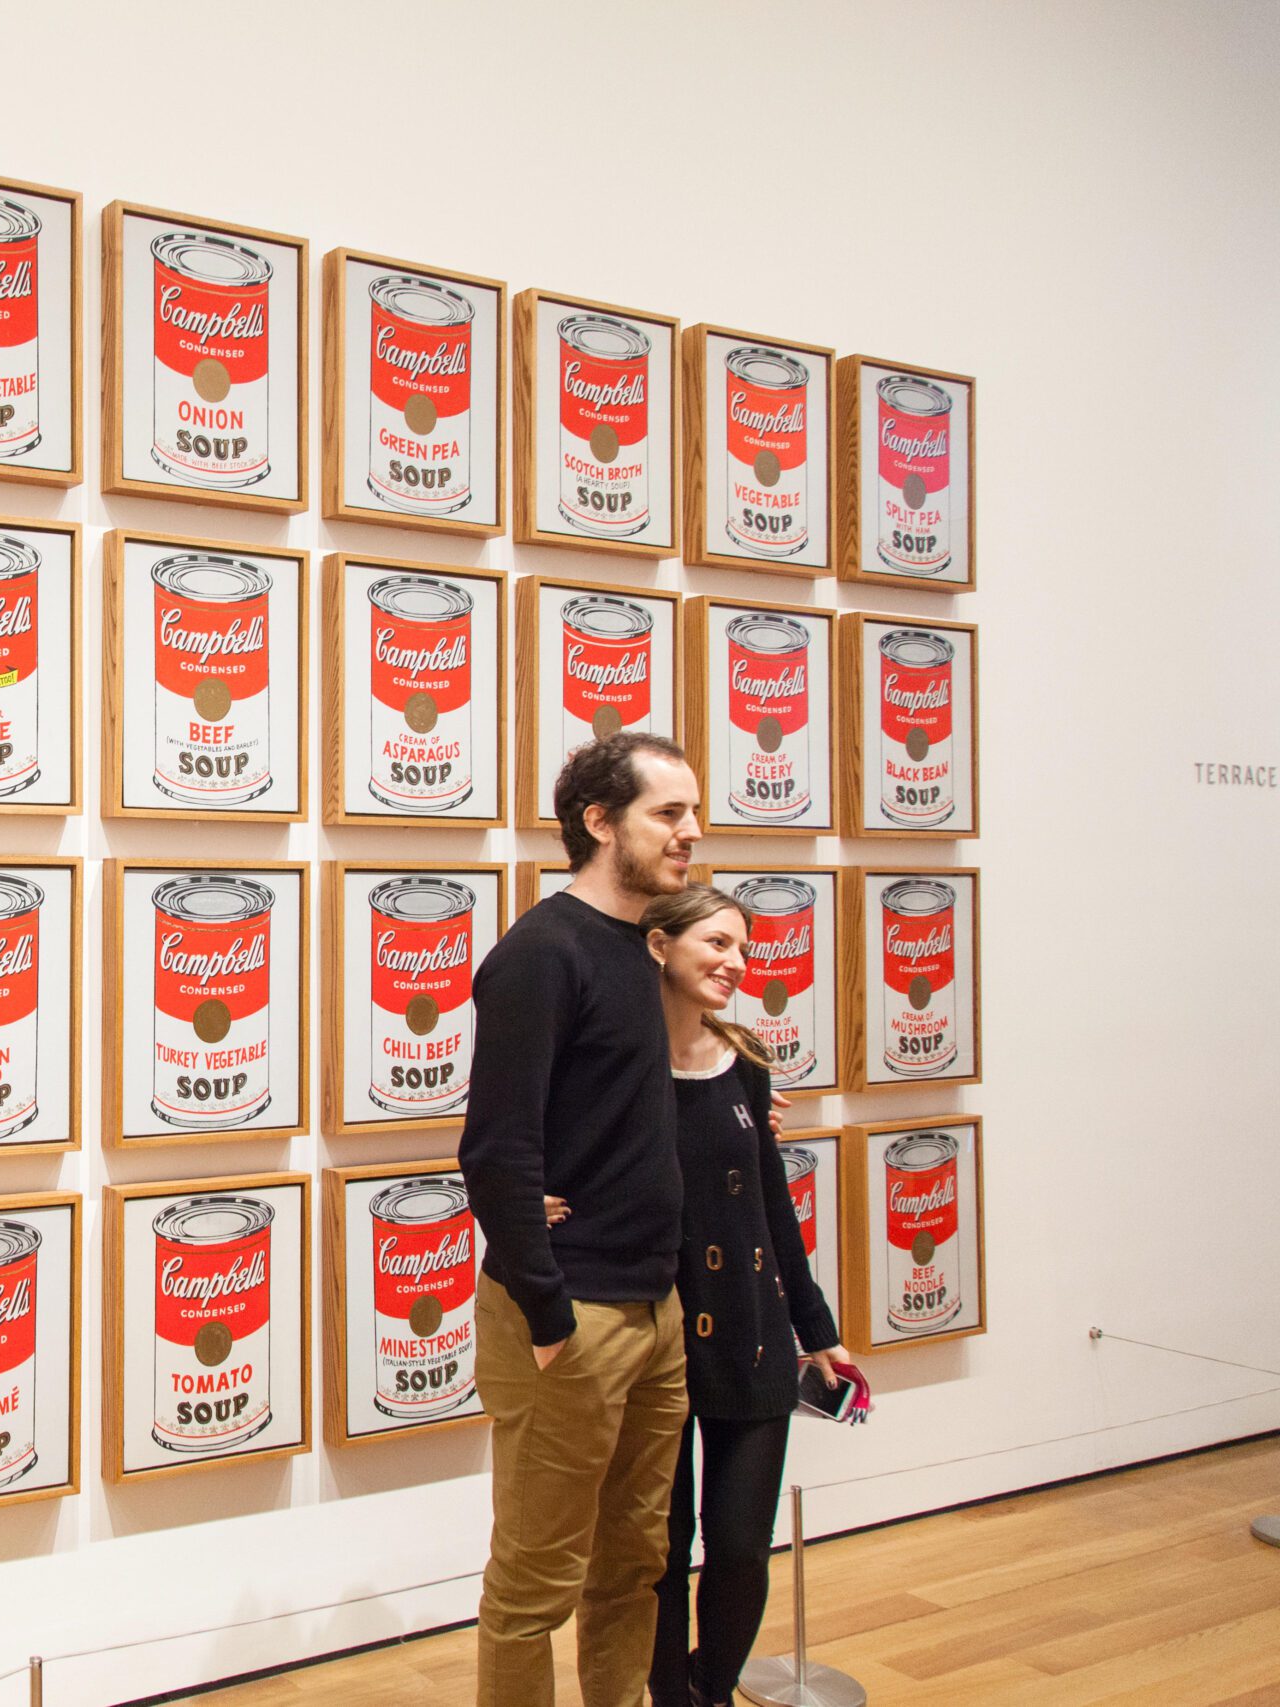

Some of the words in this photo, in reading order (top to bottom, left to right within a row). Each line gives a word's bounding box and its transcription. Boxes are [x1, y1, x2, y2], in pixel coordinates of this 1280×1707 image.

[160, 284, 264, 344] Campbell's
[179, 339, 244, 358] CONDENSED
[392, 376, 449, 393] CONDENSED
[178, 400, 243, 430] ONION
[579, 408, 629, 423] CONDENSED
[176, 429, 248, 460] SOUP
[379, 428, 427, 461] GREEN
[432, 440, 460, 461] PEA
[388, 459, 451, 488] SOUP
[564, 453, 604, 480] SCOTCH
[608, 463, 642, 480] BROTH
[577, 486, 632, 512] SOUP
[734, 482, 800, 509] VEGETABLE
[743, 508, 792, 533] SOUP
[886, 500, 915, 525] SPLIT
[919, 510, 941, 525] PEA
[892, 530, 936, 553] SOUP
[161, 608, 264, 665] Campbell's
[180, 661, 245, 675] CONDENSED
[393, 677, 450, 689] CONDENSED
[582, 690, 632, 702] CONDENSED
[189, 721, 234, 744] BEEF
[398, 733, 427, 745] CREAM
[431, 736, 440, 745] OF
[383, 740, 460, 763] ASPARAGUS
[178, 751, 249, 778] SOUP
[390, 762, 452, 786] SOUP
[746, 761, 792, 780] CELERY
[886, 759, 920, 782] BLACK
[923, 761, 948, 781] BEAN
[1194, 762, 1277, 788] TERRACE
[745, 778, 794, 800] SOUP
[895, 785, 939, 806] SOUP
[748, 925, 810, 968] ampbell's
[160, 932, 265, 987] Campbell's
[179, 984, 245, 996] CONDENSED
[393, 979, 451, 990] CONDENSED
[756, 1017, 781, 1027] CREAM
[784, 1016, 791, 1026] OF
[891, 1016, 949, 1035] MUSHROOM
[383, 1037, 421, 1060] CHILI
[426, 1033, 461, 1060] BEEF
[752, 1026, 798, 1044] HICKEN
[898, 1032, 943, 1055] SOUP
[156, 1042, 198, 1069] TURKEY
[205, 1040, 267, 1070] VEGETABLE
[176, 1072, 248, 1101] SOUP
[391, 1062, 454, 1089] SOUP
[733, 1104, 755, 1128] H
[904, 1272, 944, 1292] NOODLE
[912, 1265, 935, 1279] BEEF
[396, 1277, 454, 1294] CONDENSED
[180, 1303, 246, 1318] CONDENSED
[903, 1286, 946, 1311] SOUP
[379, 1320, 471, 1358] MINESTRONE
[427, 1350, 457, 1365] VEGETABLE
[171, 1363, 253, 1395] TOMATO
[395, 1360, 458, 1392] SOUP
[176, 1392, 249, 1425] SOUP
